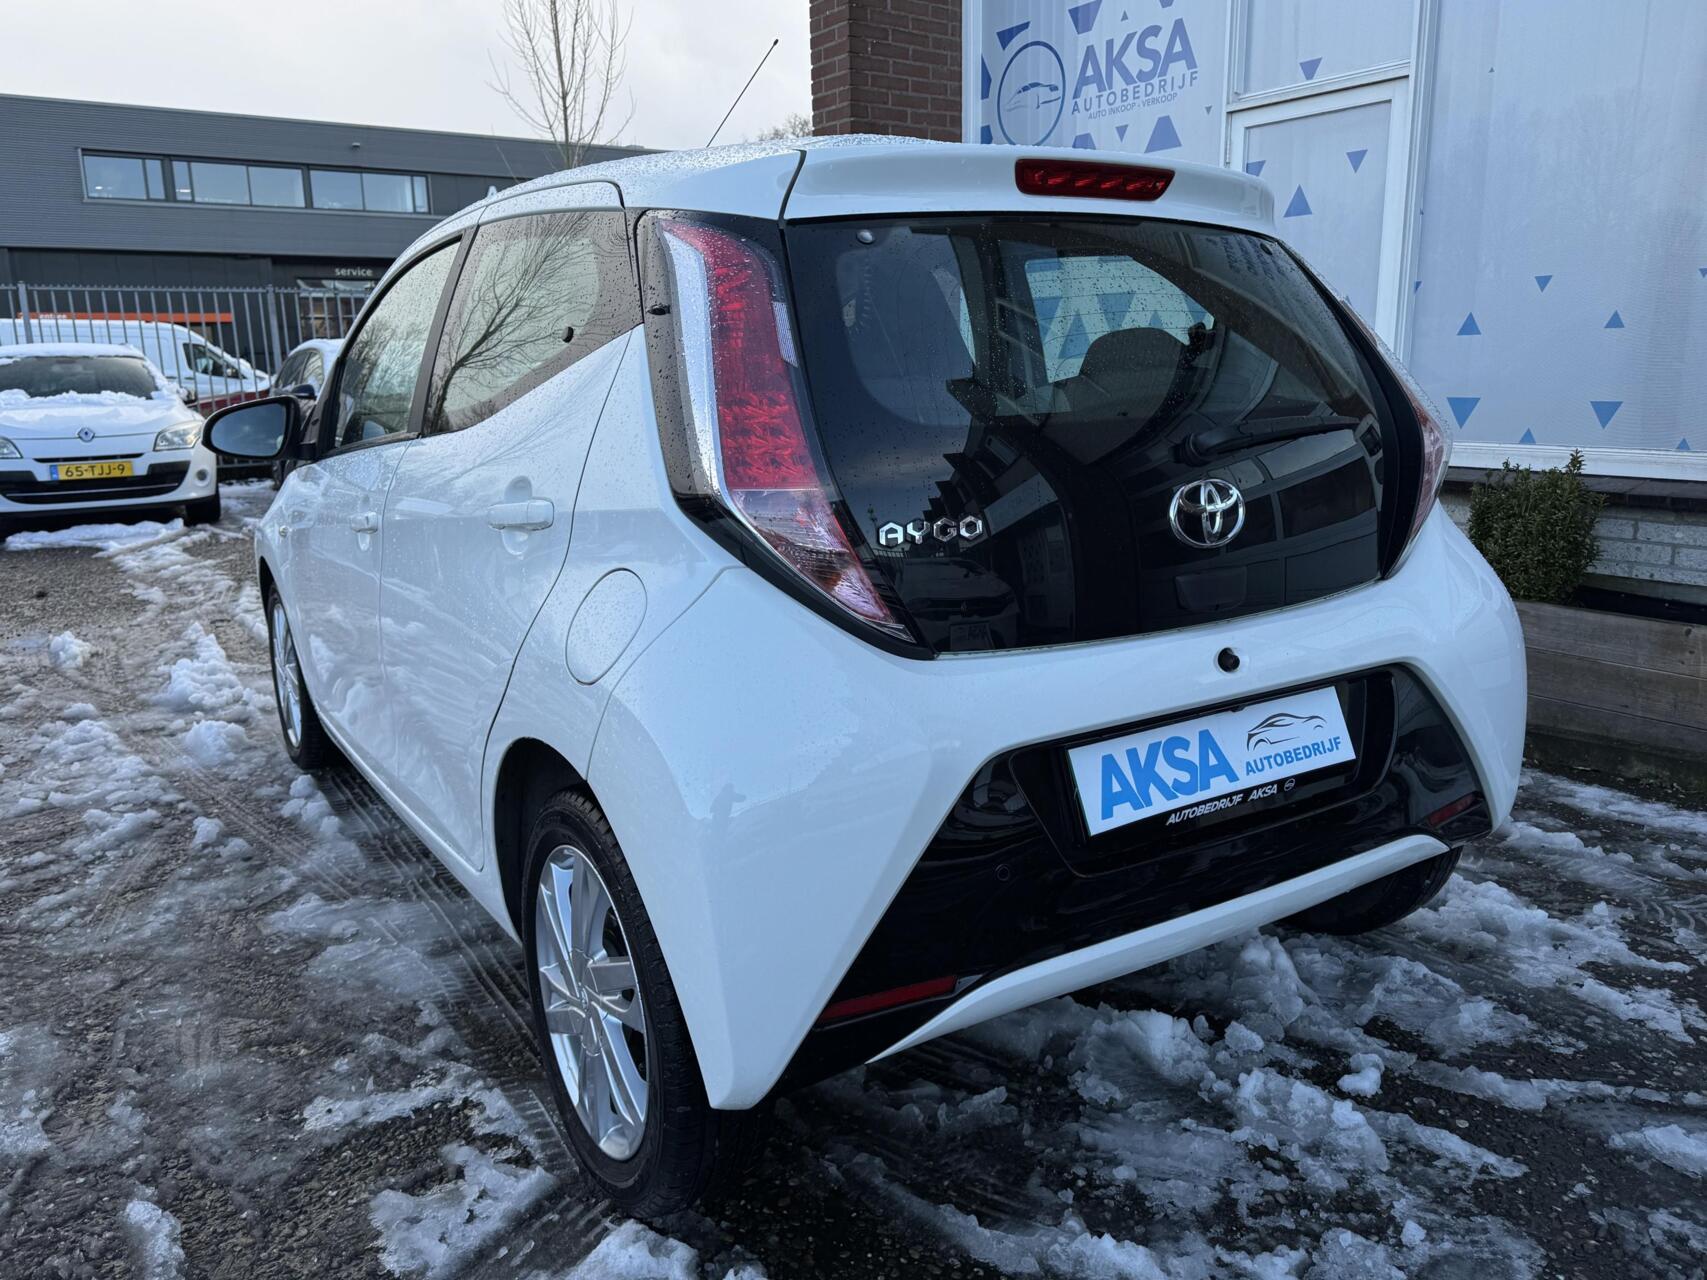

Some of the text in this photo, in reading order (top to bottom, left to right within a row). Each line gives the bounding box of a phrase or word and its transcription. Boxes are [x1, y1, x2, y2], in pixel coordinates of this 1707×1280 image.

[1072, 17, 1198, 100] AKSA
[1071, 71, 1199, 115] AUTOBEDRIJF
[1088, 108, 1107, 120] AUTO
[1108, 101, 1137, 115] INKOOP
[1142, 92, 1178, 107] VERKOOP
[335, 266, 373, 277] service
[65, 463, 126, 478] 65-TJJ-9
[879, 515, 983, 546] AYGO
[1101, 729, 1240, 821] AKSA
[1245, 736, 1342, 777] AUTOBEDRIJF
[1165, 783, 1278, 826] AUTOBEDRIJF AKSA
